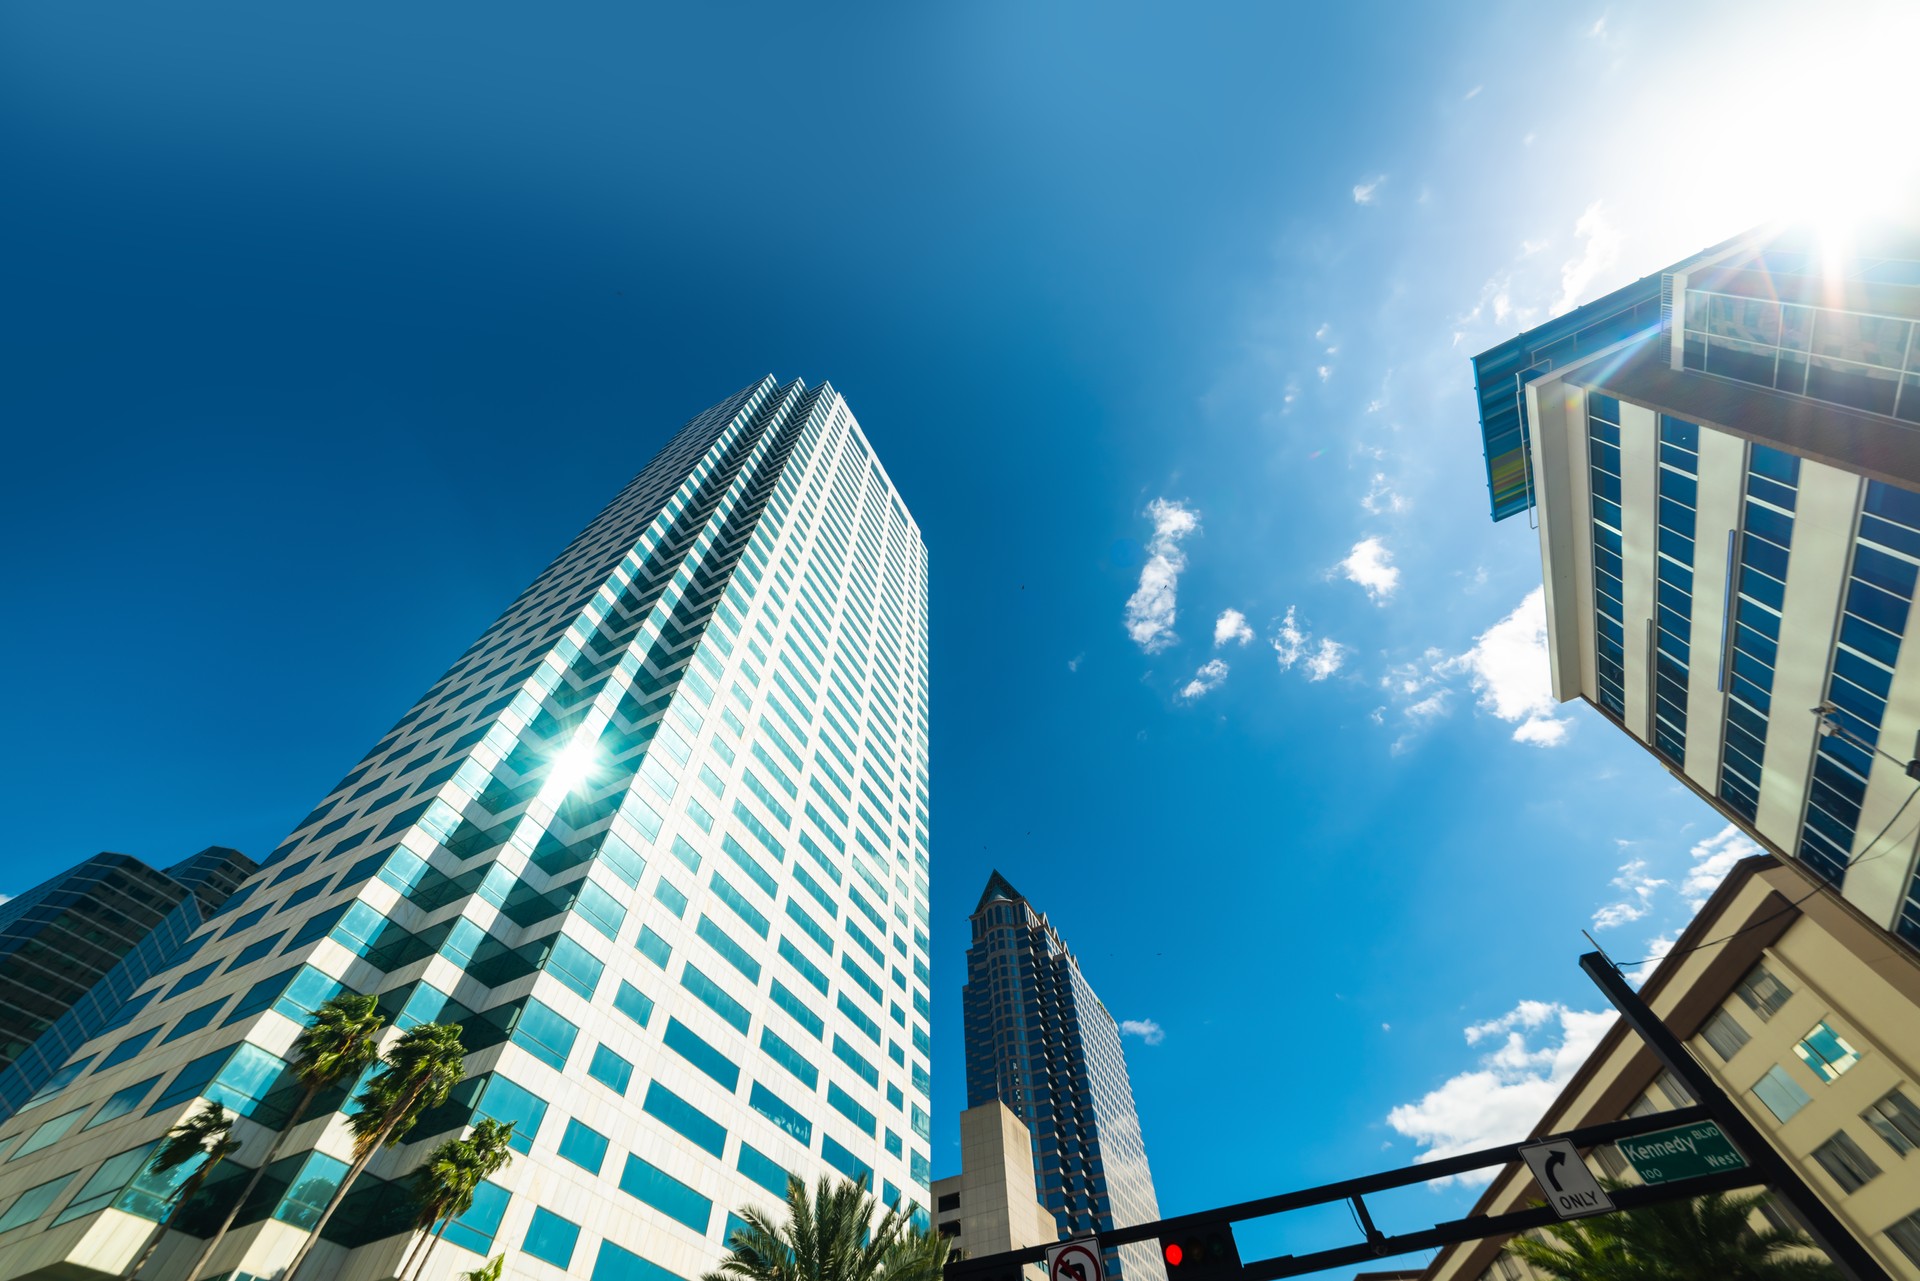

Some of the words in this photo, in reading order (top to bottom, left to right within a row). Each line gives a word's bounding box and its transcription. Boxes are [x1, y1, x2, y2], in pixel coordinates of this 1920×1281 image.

[1624, 1135, 1698, 1162] Kennedy
[1692, 1127, 1719, 1139] BLVD
[1641, 1168, 1662, 1180] 100
[1704, 1152, 1741, 1168] West
[1559, 1190, 1599, 1210] ONLY
